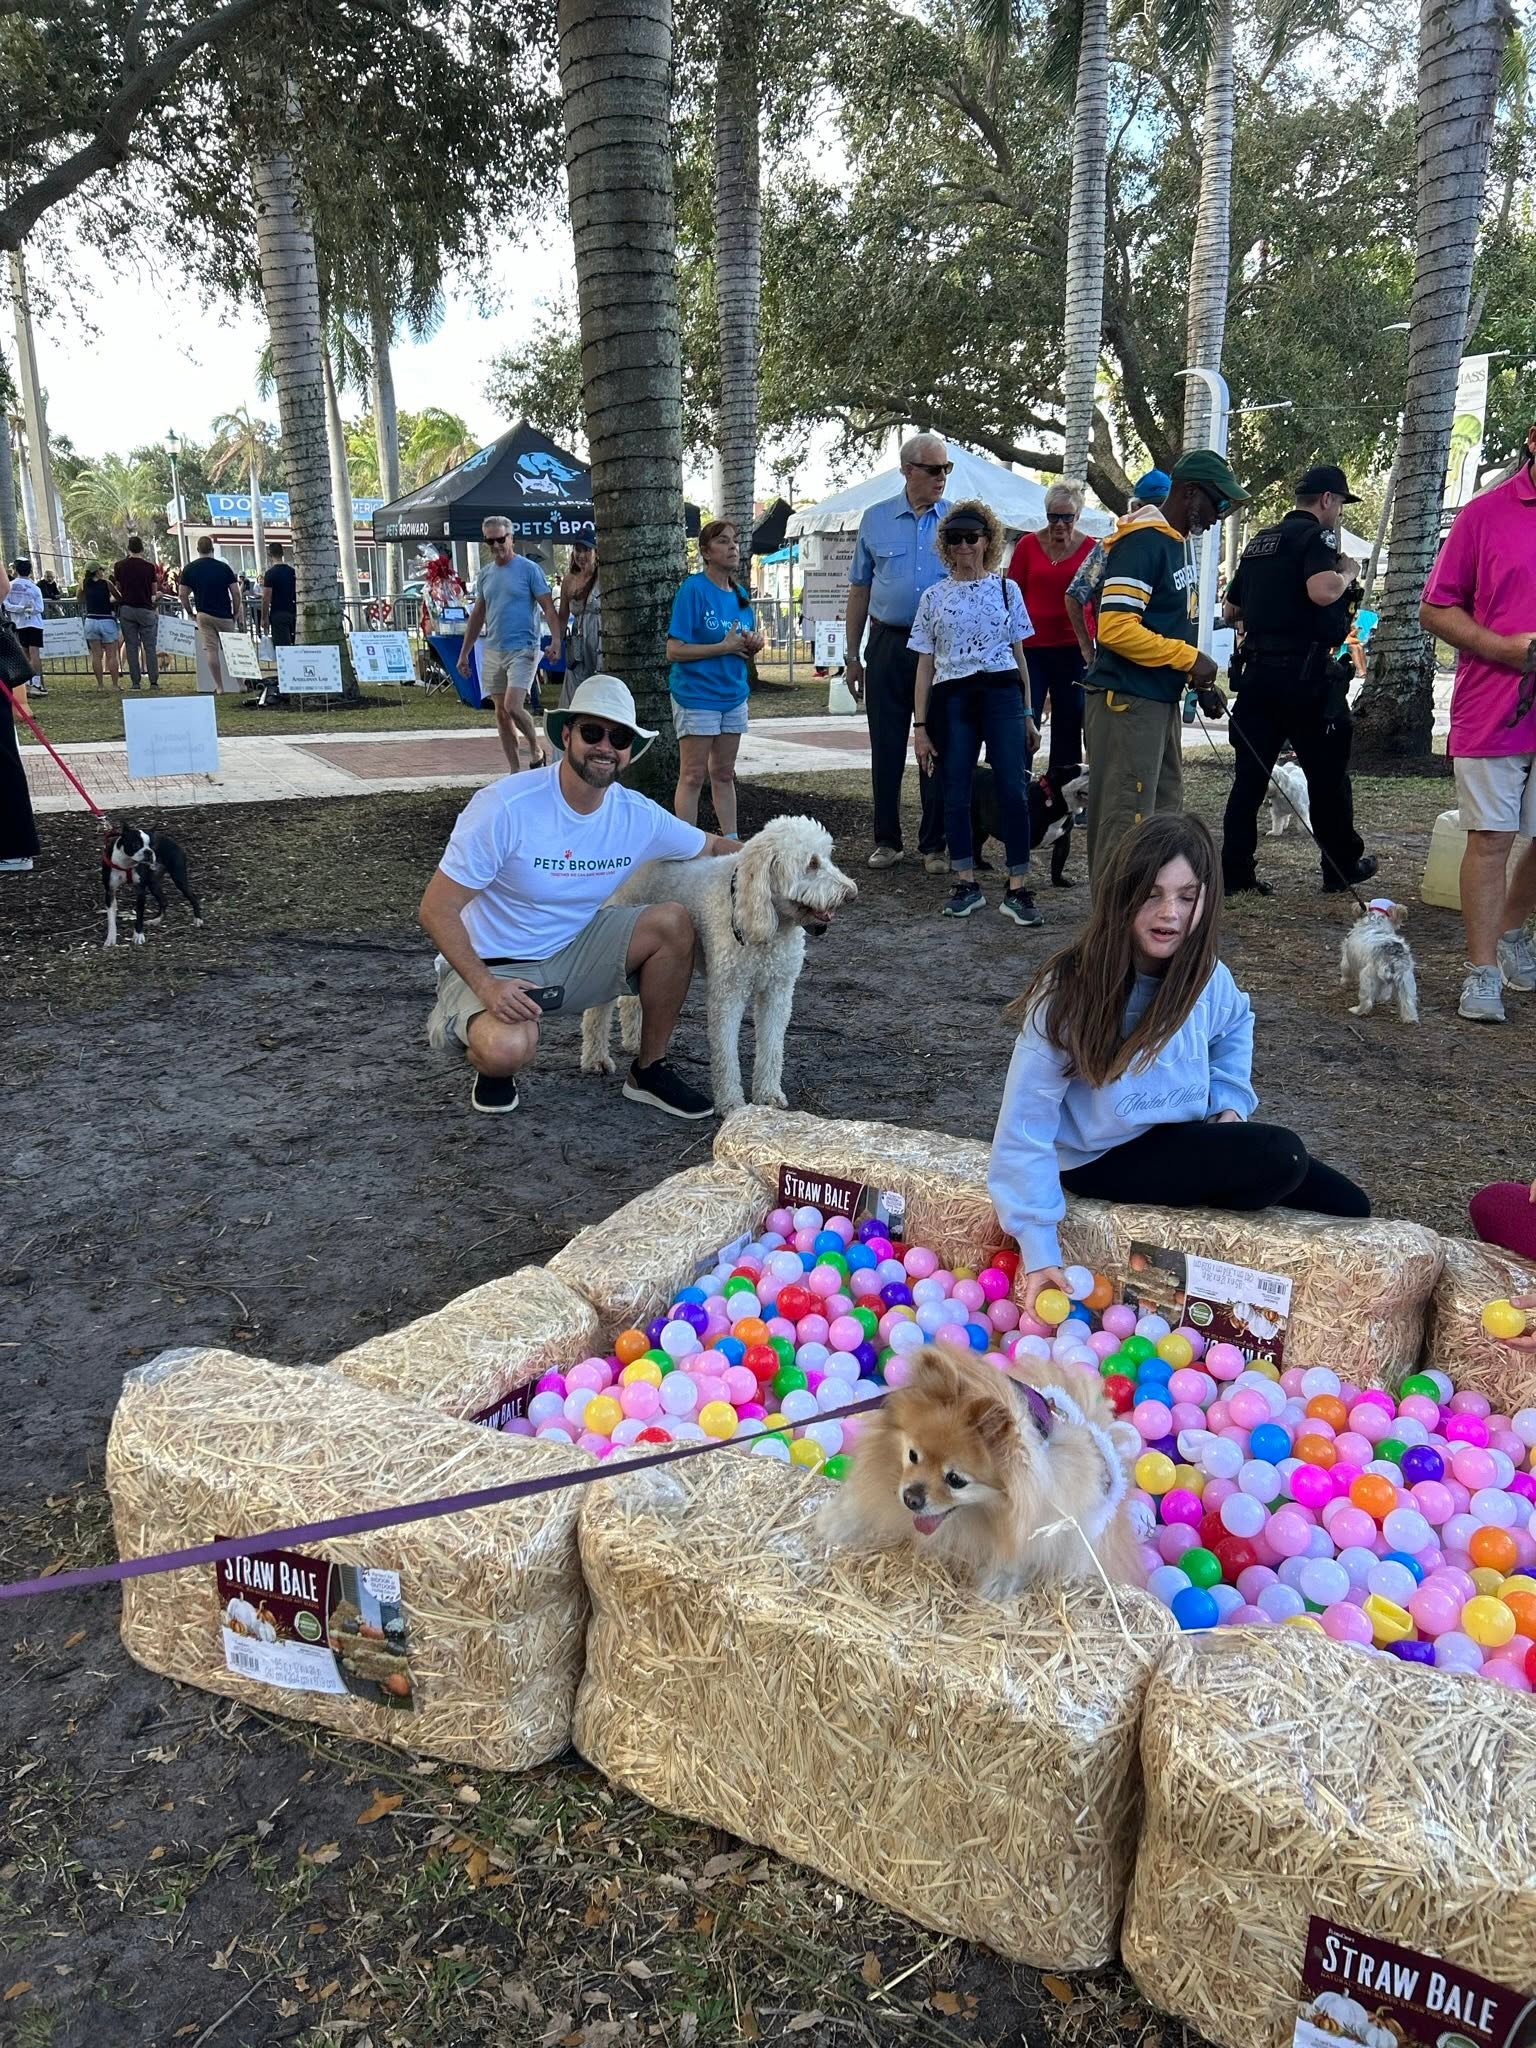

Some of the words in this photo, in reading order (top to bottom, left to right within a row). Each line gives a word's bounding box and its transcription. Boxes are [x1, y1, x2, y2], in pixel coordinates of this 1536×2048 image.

[398, 522, 429, 536] BROWARD
[1248, 542, 1276, 554] POLICE
[534, 858, 566, 870] PETS
[570, 856, 632, 871] BROWARD
[784, 1174, 822, 1203] STRAW
[824, 1183, 851, 1211] BALE
[224, 1555, 274, 1592] STRAW
[280, 1561, 318, 1602] BALE
[1322, 1935, 1420, 2001] STRAW
[1426, 1971, 1498, 2034] BALE
